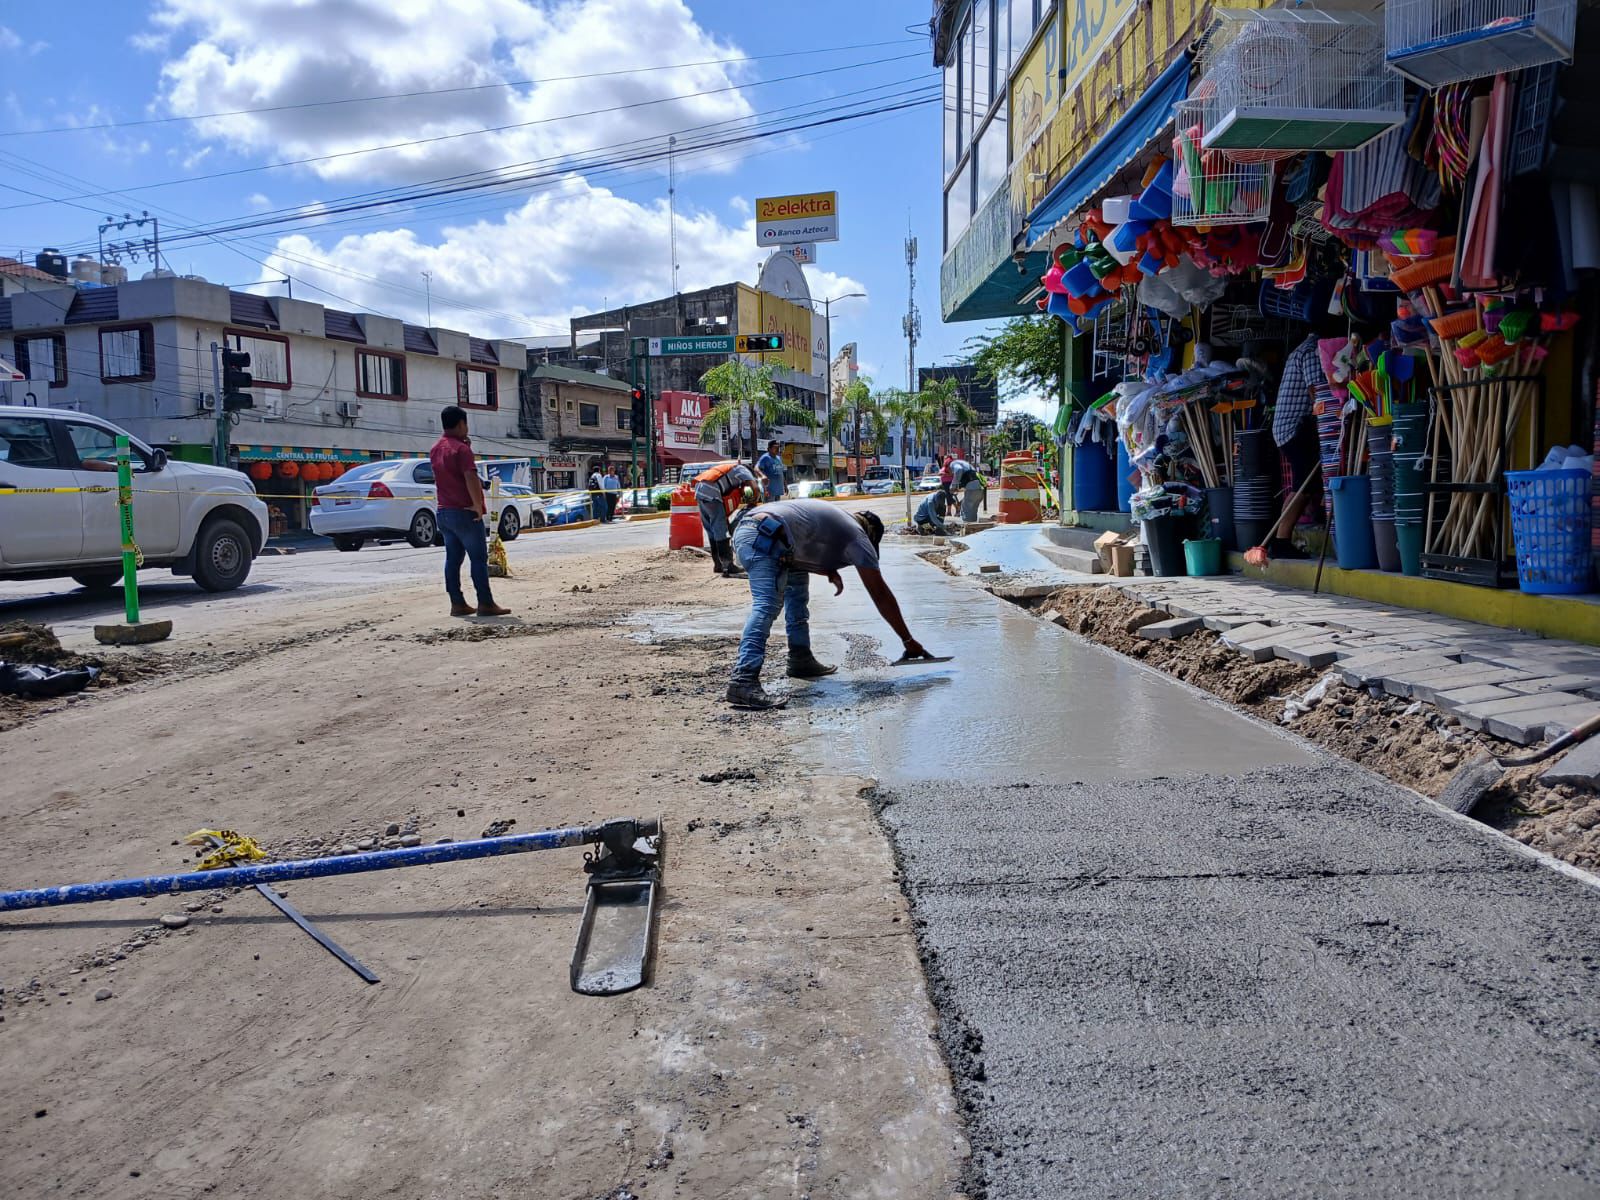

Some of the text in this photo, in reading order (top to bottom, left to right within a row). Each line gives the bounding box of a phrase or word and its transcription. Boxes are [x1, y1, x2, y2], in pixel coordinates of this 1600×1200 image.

[777, 199, 831, 216] elektra
[778, 226, 829, 237] Banco Azteca
[667, 340, 693, 351] NIÑOS
[695, 340, 728, 350] HEROES
[680, 396, 702, 418] AKÁ
[276, 451, 304, 460] CENTRAL
[315, 453, 339, 461] FRUTAS
